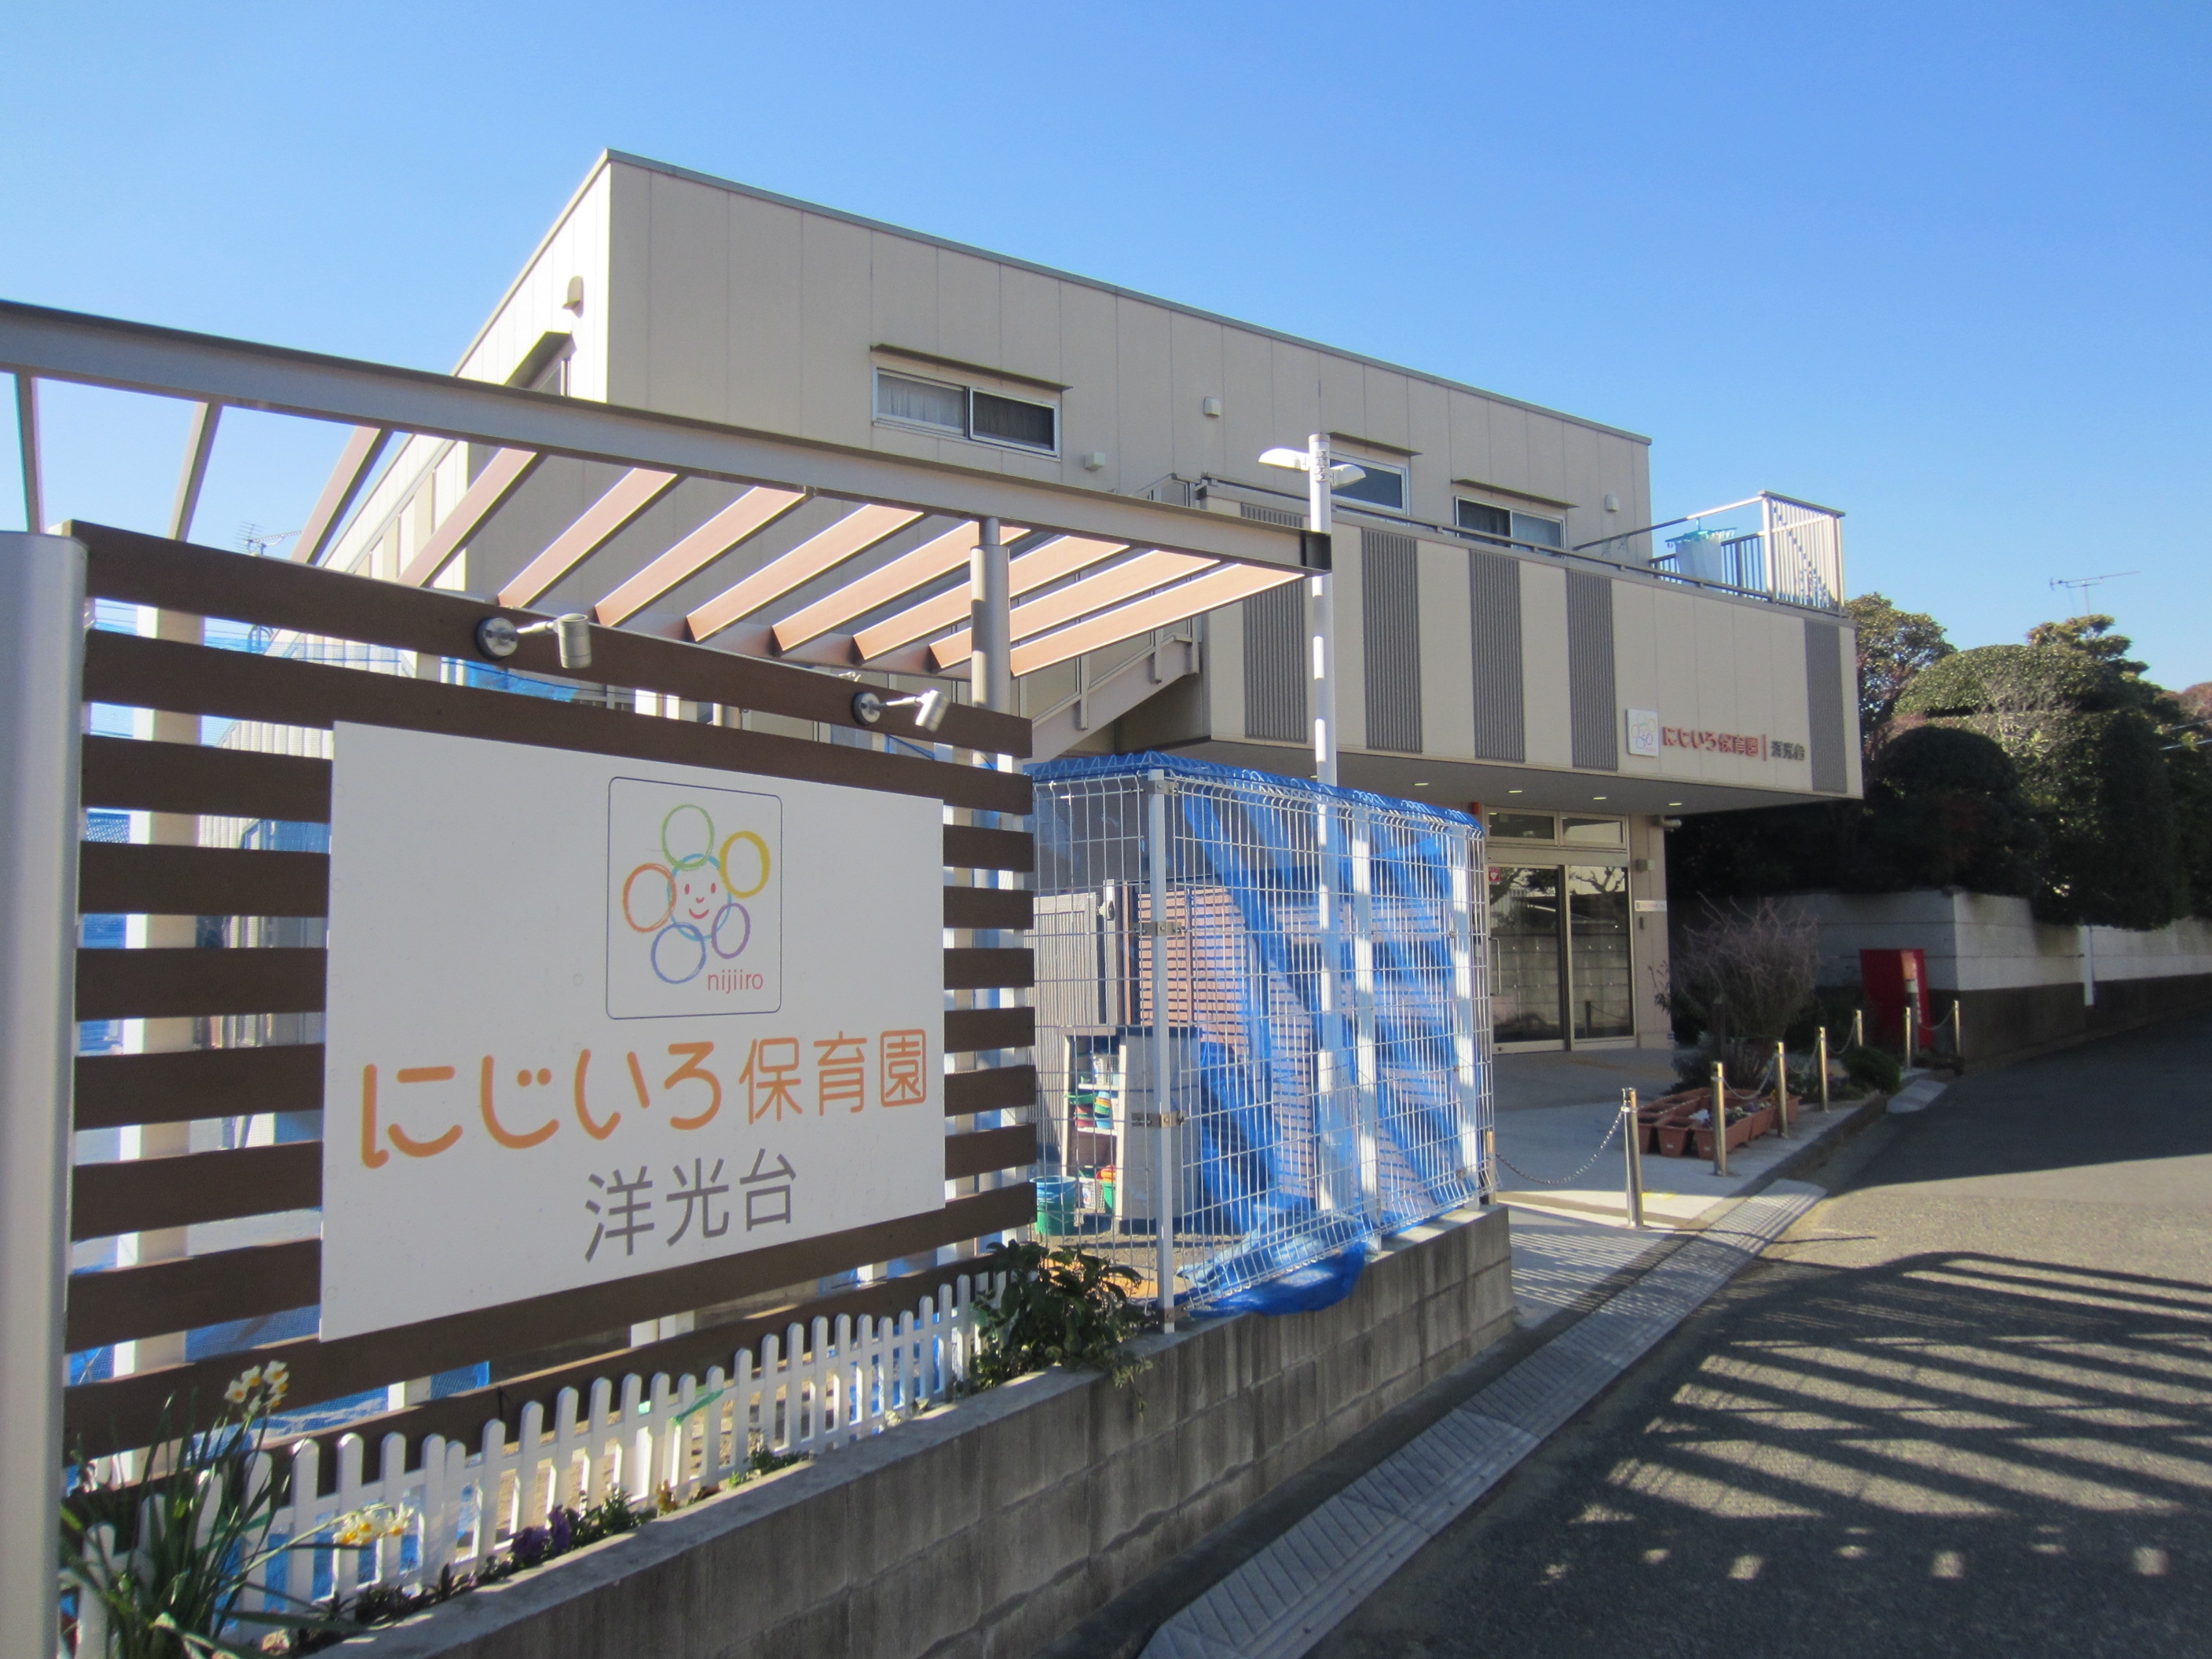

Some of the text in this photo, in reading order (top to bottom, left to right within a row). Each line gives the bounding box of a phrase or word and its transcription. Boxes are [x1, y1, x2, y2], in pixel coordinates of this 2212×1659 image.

[708, 969, 764, 994] nijiiro
[361, 1029, 927, 1169] にじいろ保育園
[584, 1148, 797, 1262] 洋光台
